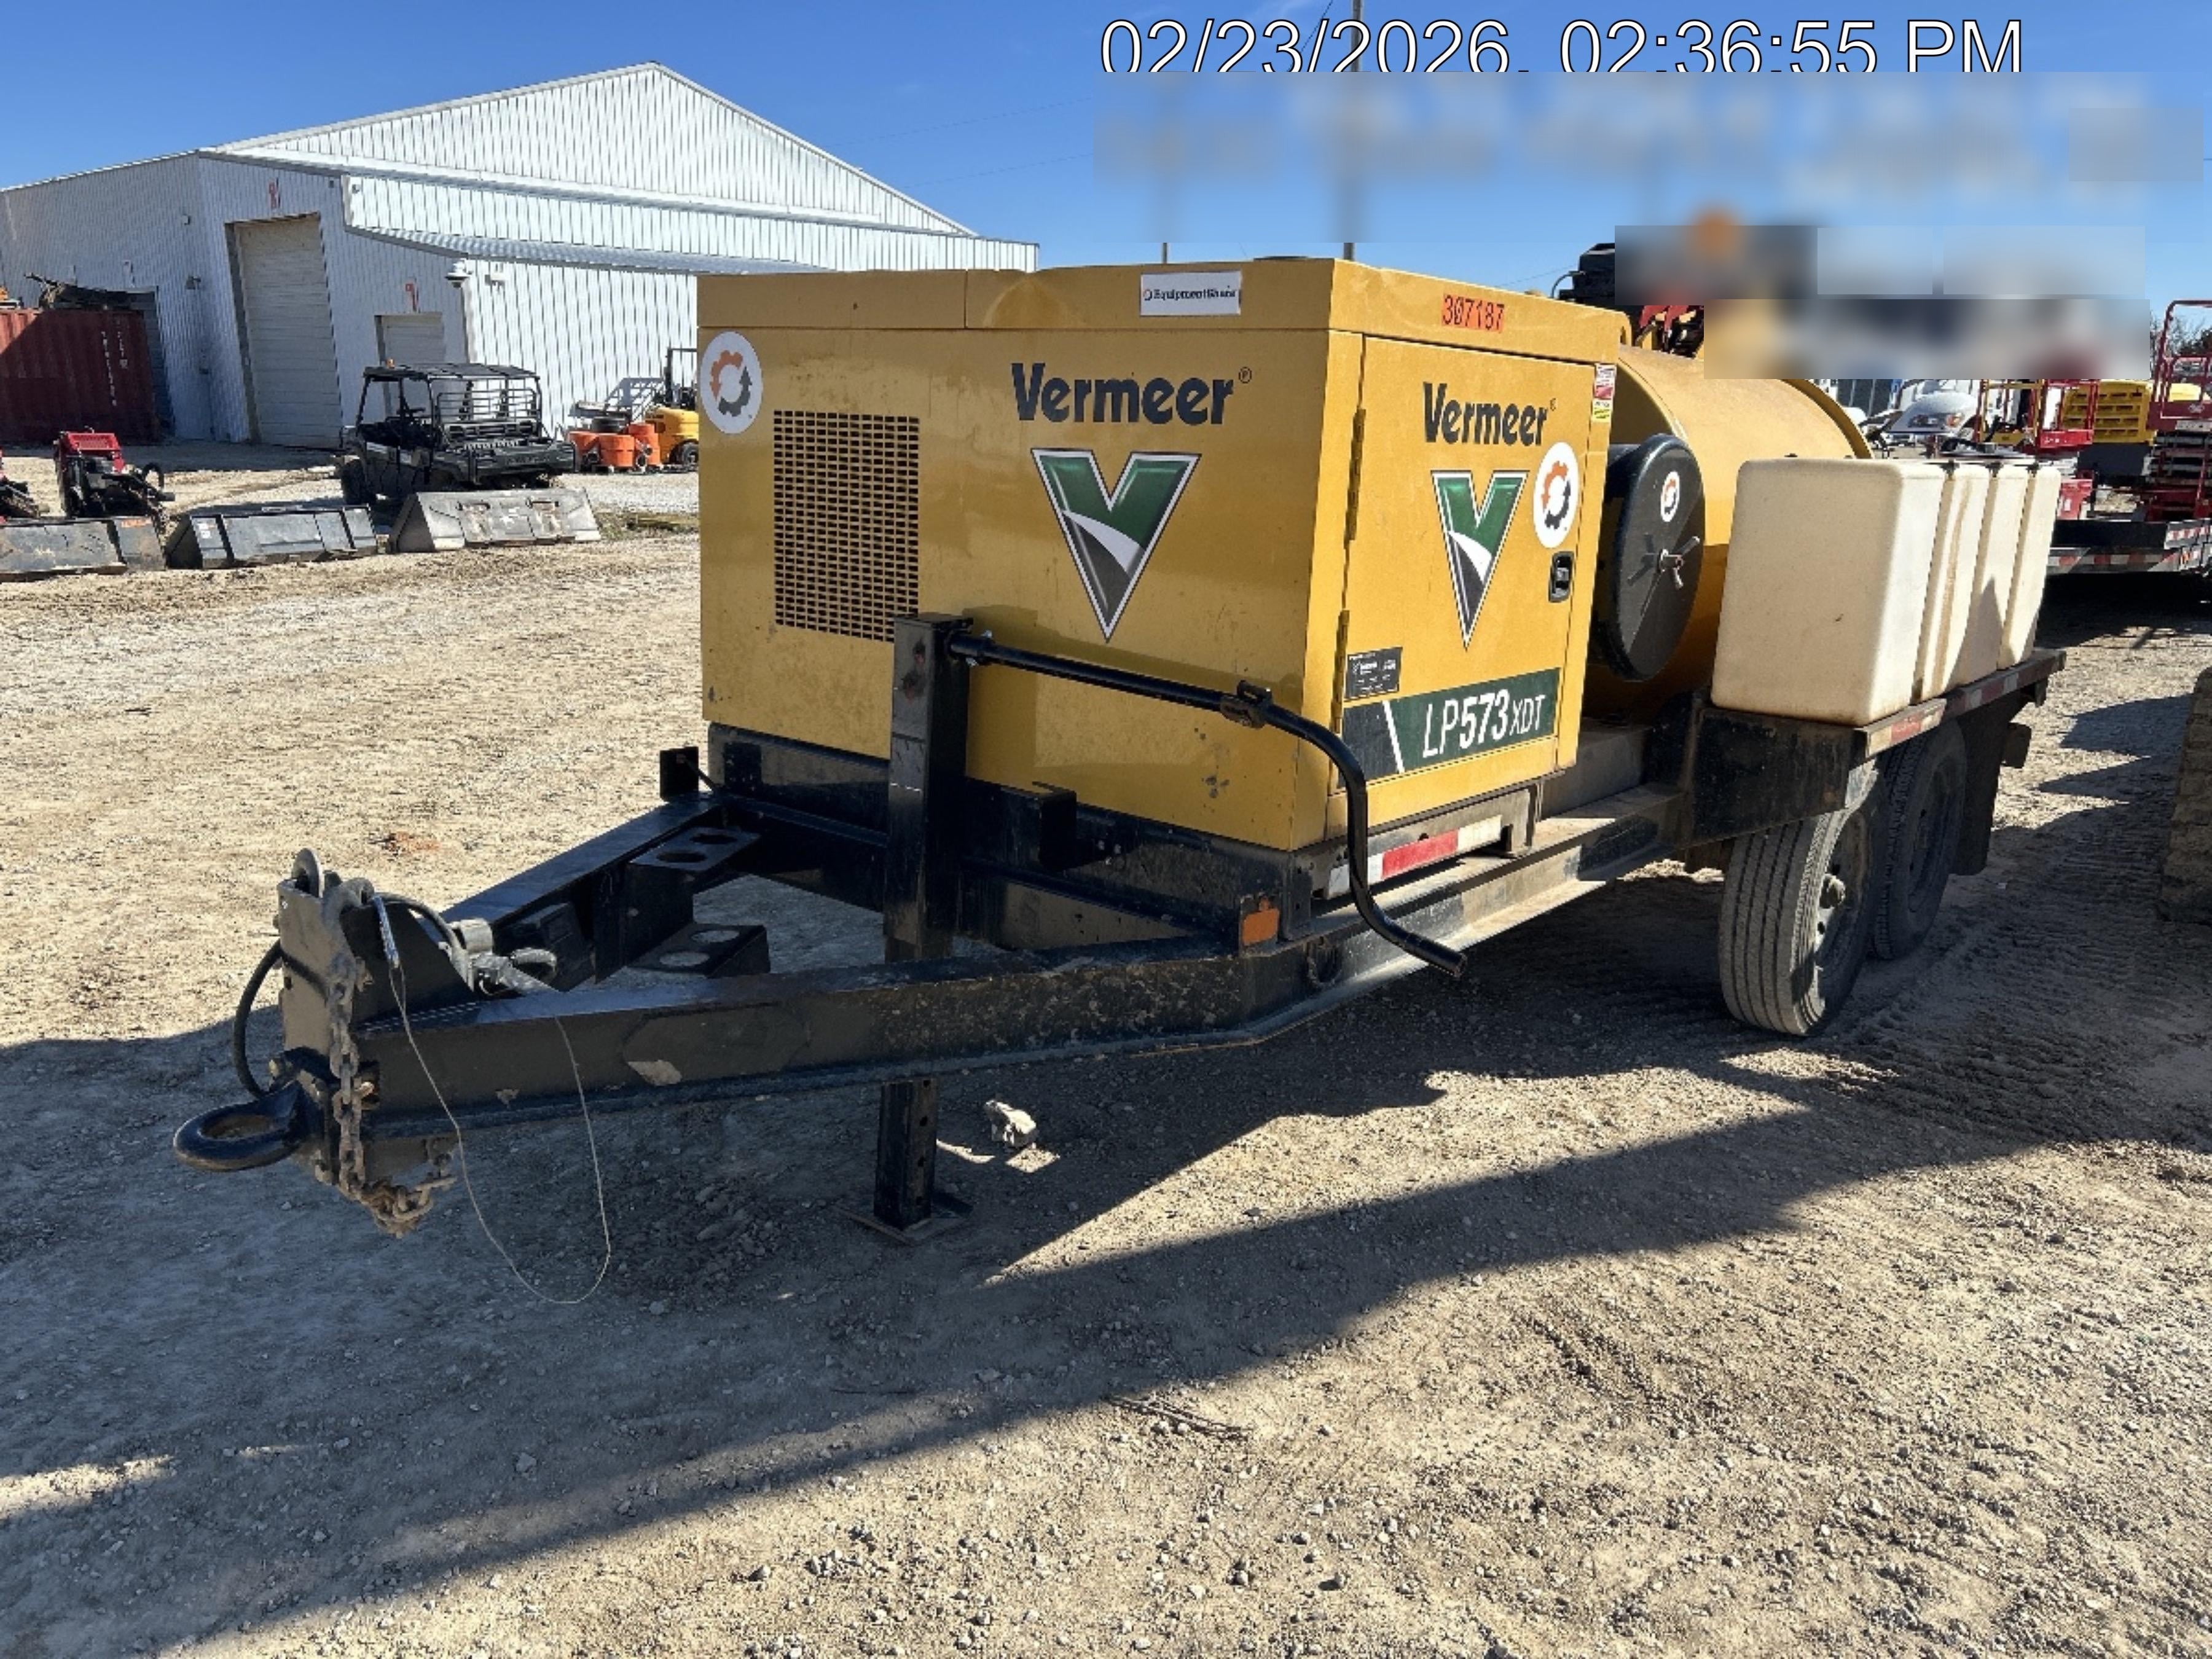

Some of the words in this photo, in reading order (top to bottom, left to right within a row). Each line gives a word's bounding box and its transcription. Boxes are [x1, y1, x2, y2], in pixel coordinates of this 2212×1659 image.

[1442, 295, 1505, 331] 307187
[1011, 363, 1234, 426] Vermeer
[1423, 382, 1548, 447] Vermeer
